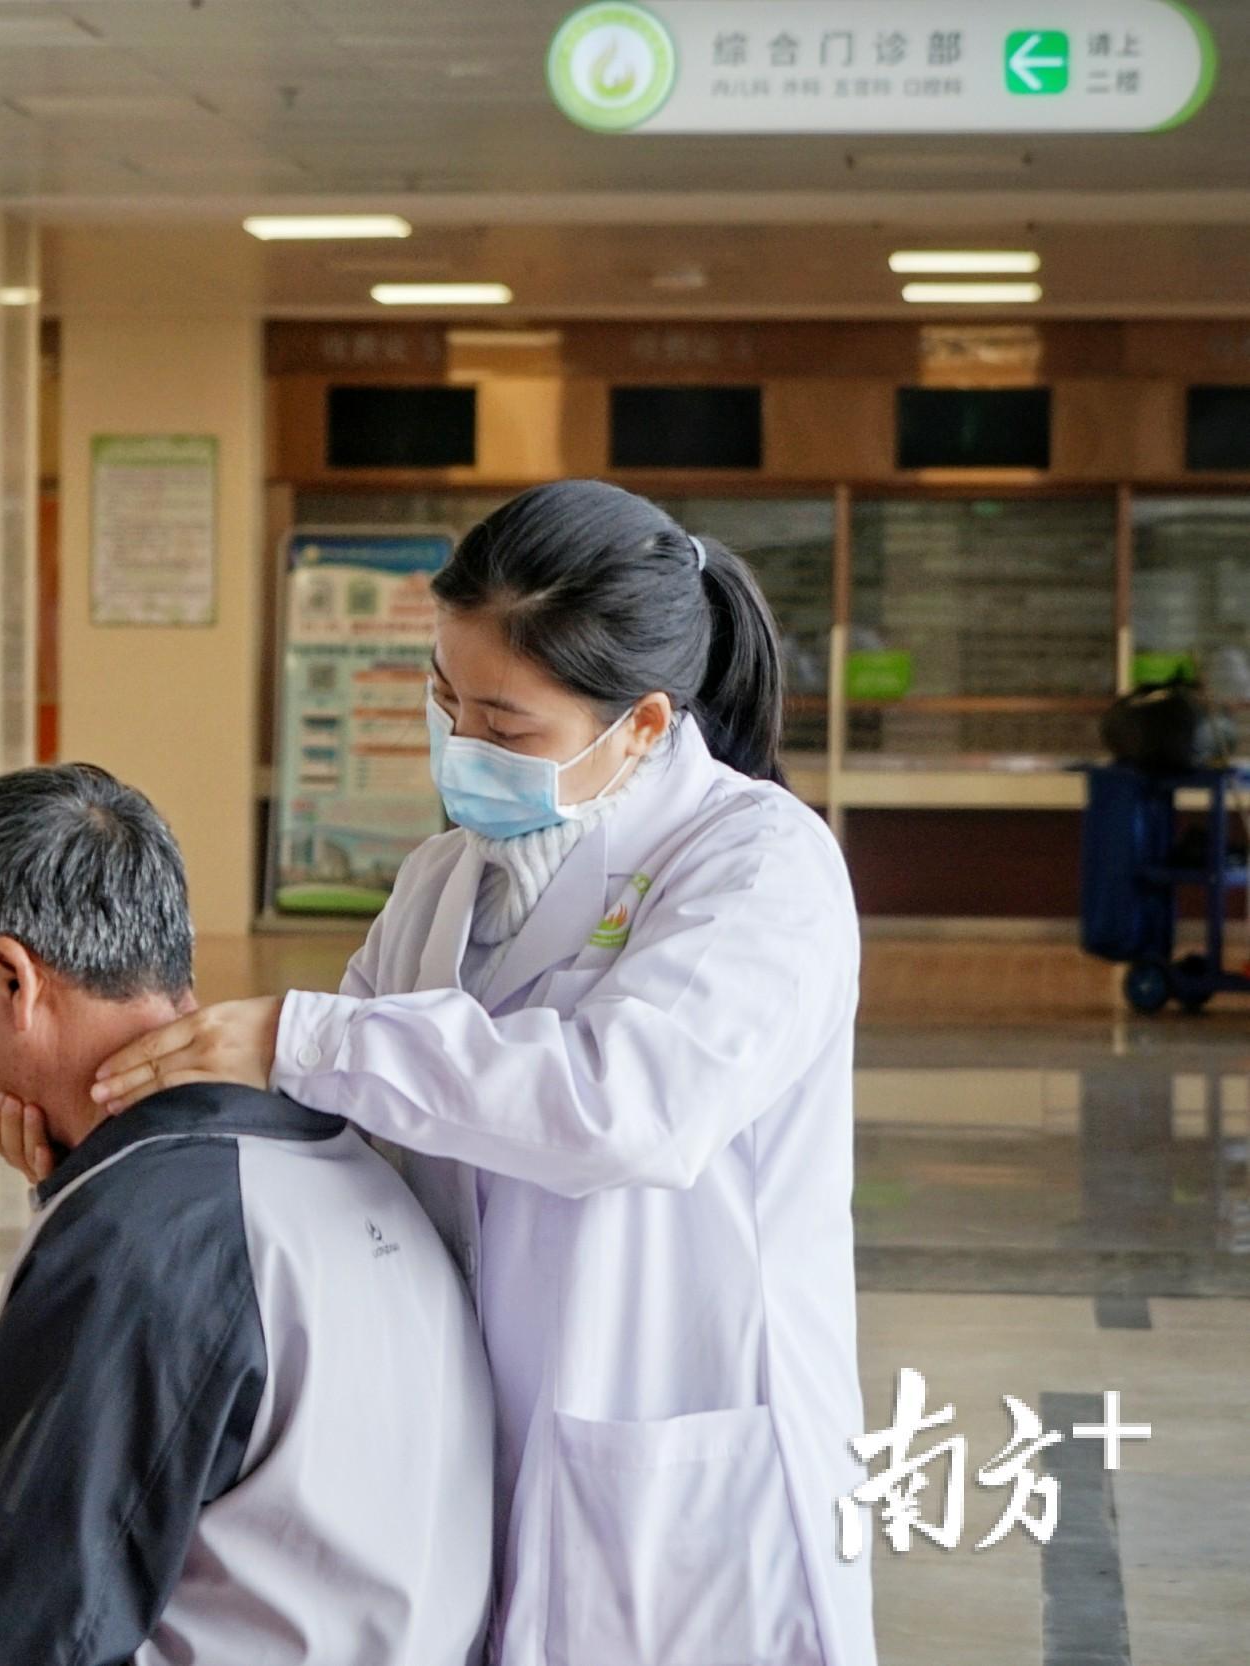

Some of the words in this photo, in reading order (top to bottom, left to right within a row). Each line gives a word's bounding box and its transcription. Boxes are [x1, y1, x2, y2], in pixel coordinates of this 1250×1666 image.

[711, 30, 962, 67] 综合门诊部
[1087, 32, 1141, 57] 请上
[1087, 69, 1140, 95] 二楼
